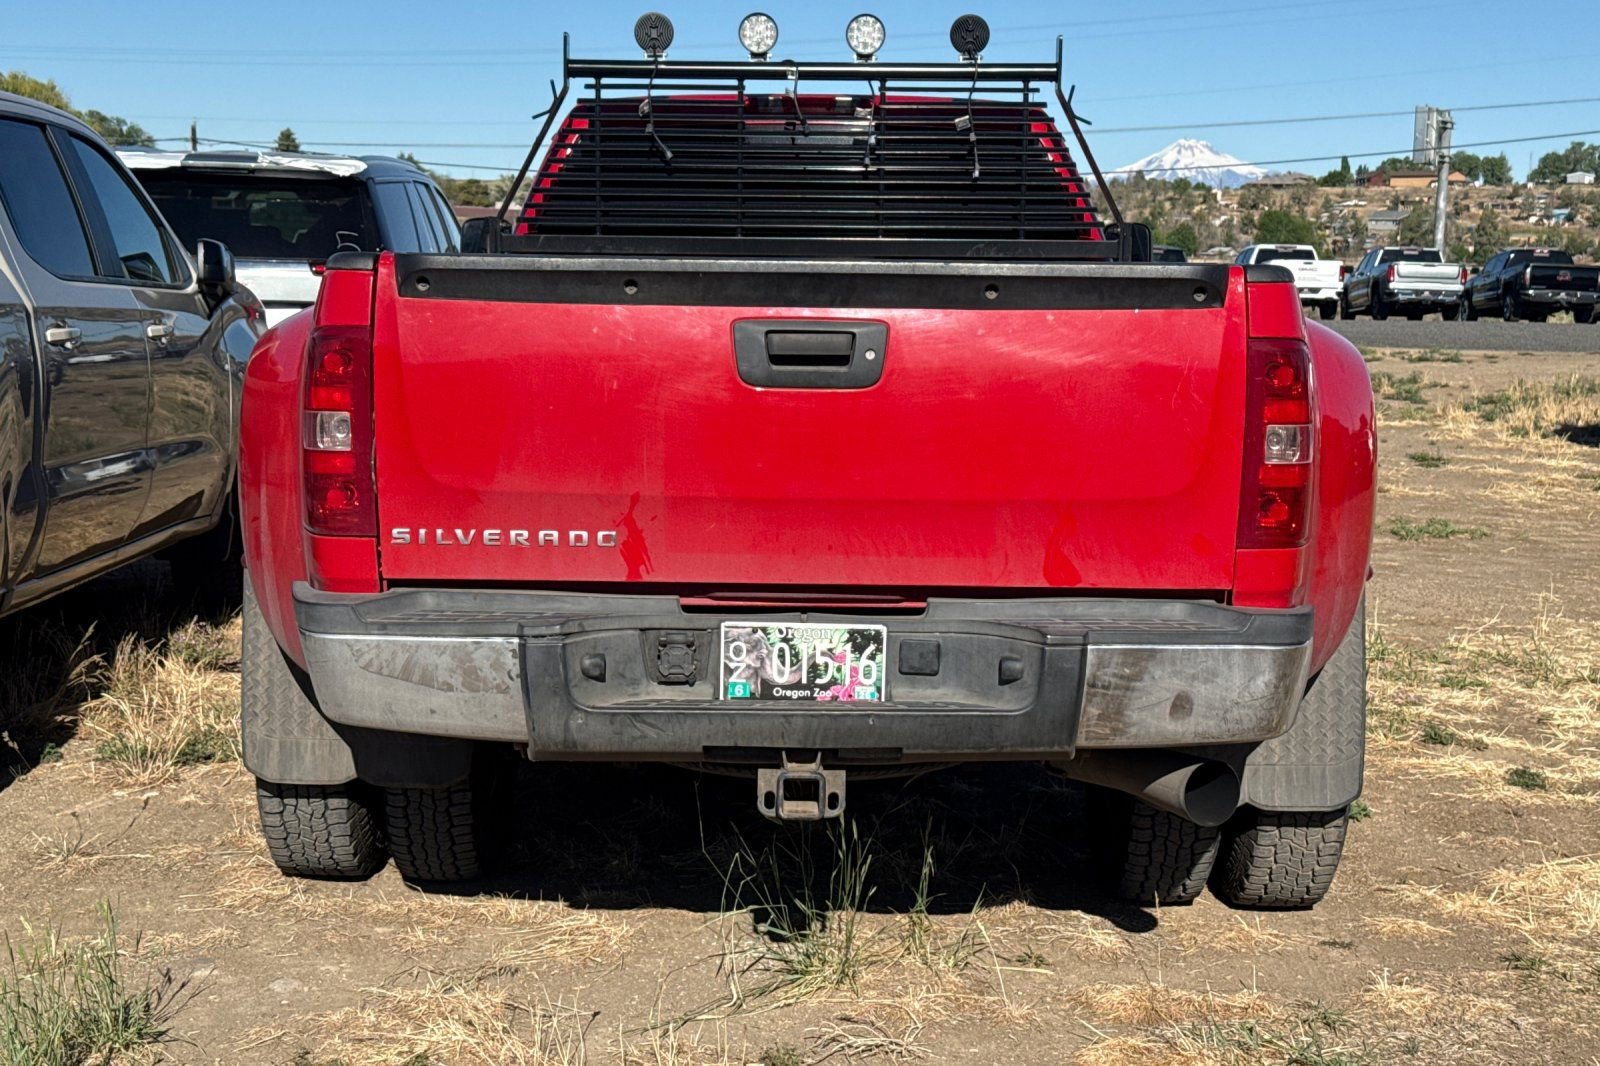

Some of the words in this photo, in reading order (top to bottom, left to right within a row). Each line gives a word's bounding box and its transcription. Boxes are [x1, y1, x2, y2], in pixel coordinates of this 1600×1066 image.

[391, 528, 616, 548] SILVERADO
[775, 627, 833, 643] Oregon
[772, 641, 878, 685] 01516
[734, 686, 744, 696] 6
[773, 687, 811, 699] Oregon
[813, 688, 833, 698] Zoo
